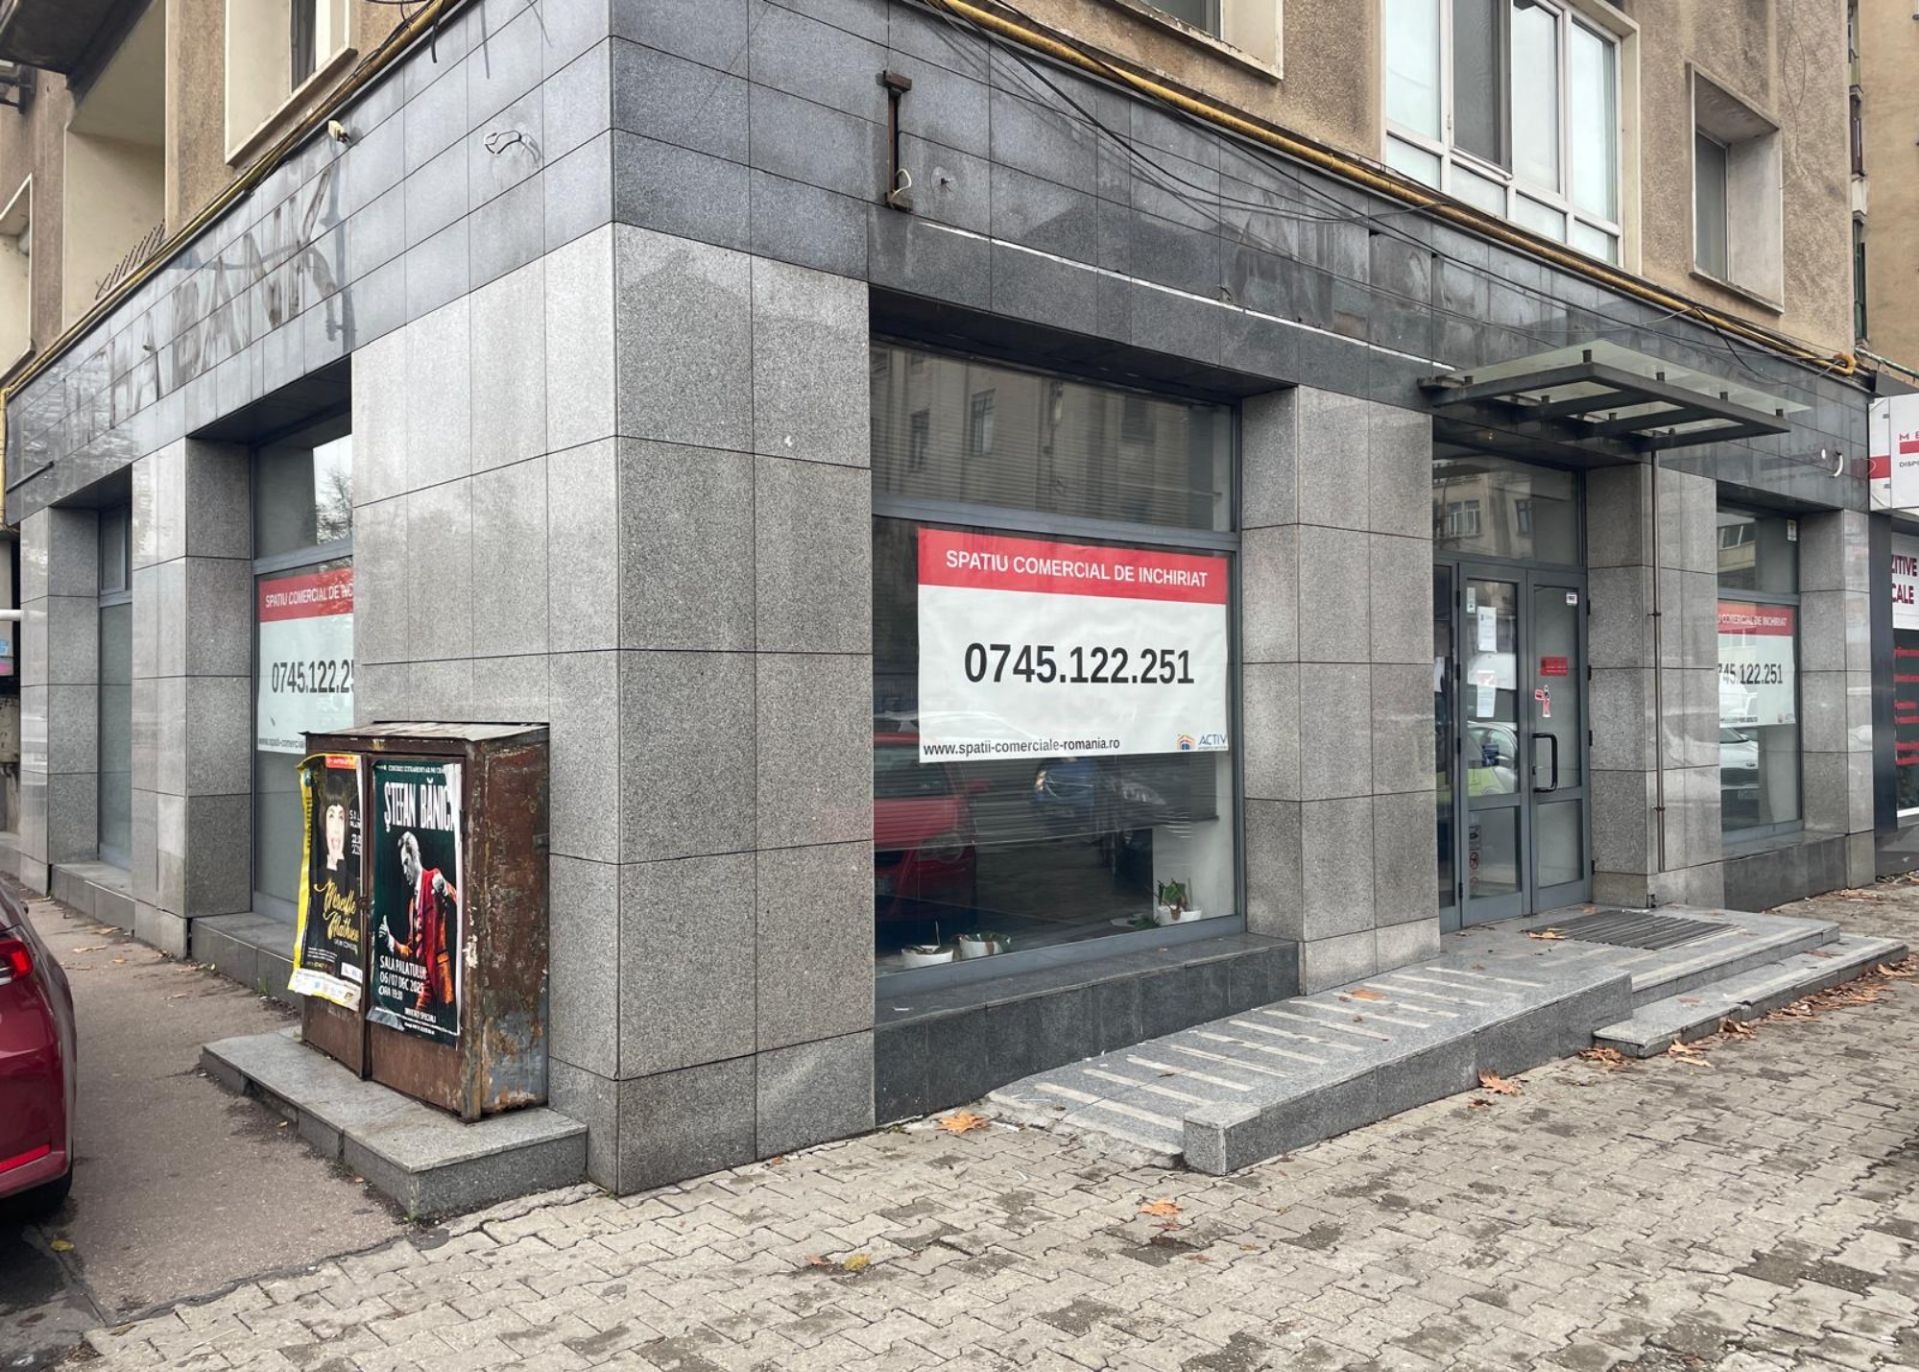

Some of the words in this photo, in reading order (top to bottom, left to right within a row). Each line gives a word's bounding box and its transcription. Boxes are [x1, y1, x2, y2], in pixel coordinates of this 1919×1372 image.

[946, 549, 1008, 572] SPATIU
[1013, 556, 1110, 581] COMERCIAL
[1113, 564, 1135, 583] DE
[1138, 567, 1209, 588] INCHIRIAT
[265, 591, 288, 609] SPATIU
[288, 587, 328, 605] COMERCIAL
[328, 585, 340, 600] DE
[964, 642, 1195, 685] 0745.122.251
[922, 738, 1121, 757] www.spatii-comerciale-romania.ro
[1198, 733, 1228, 746] ACTIV
[379, 954, 395, 971] SALA
